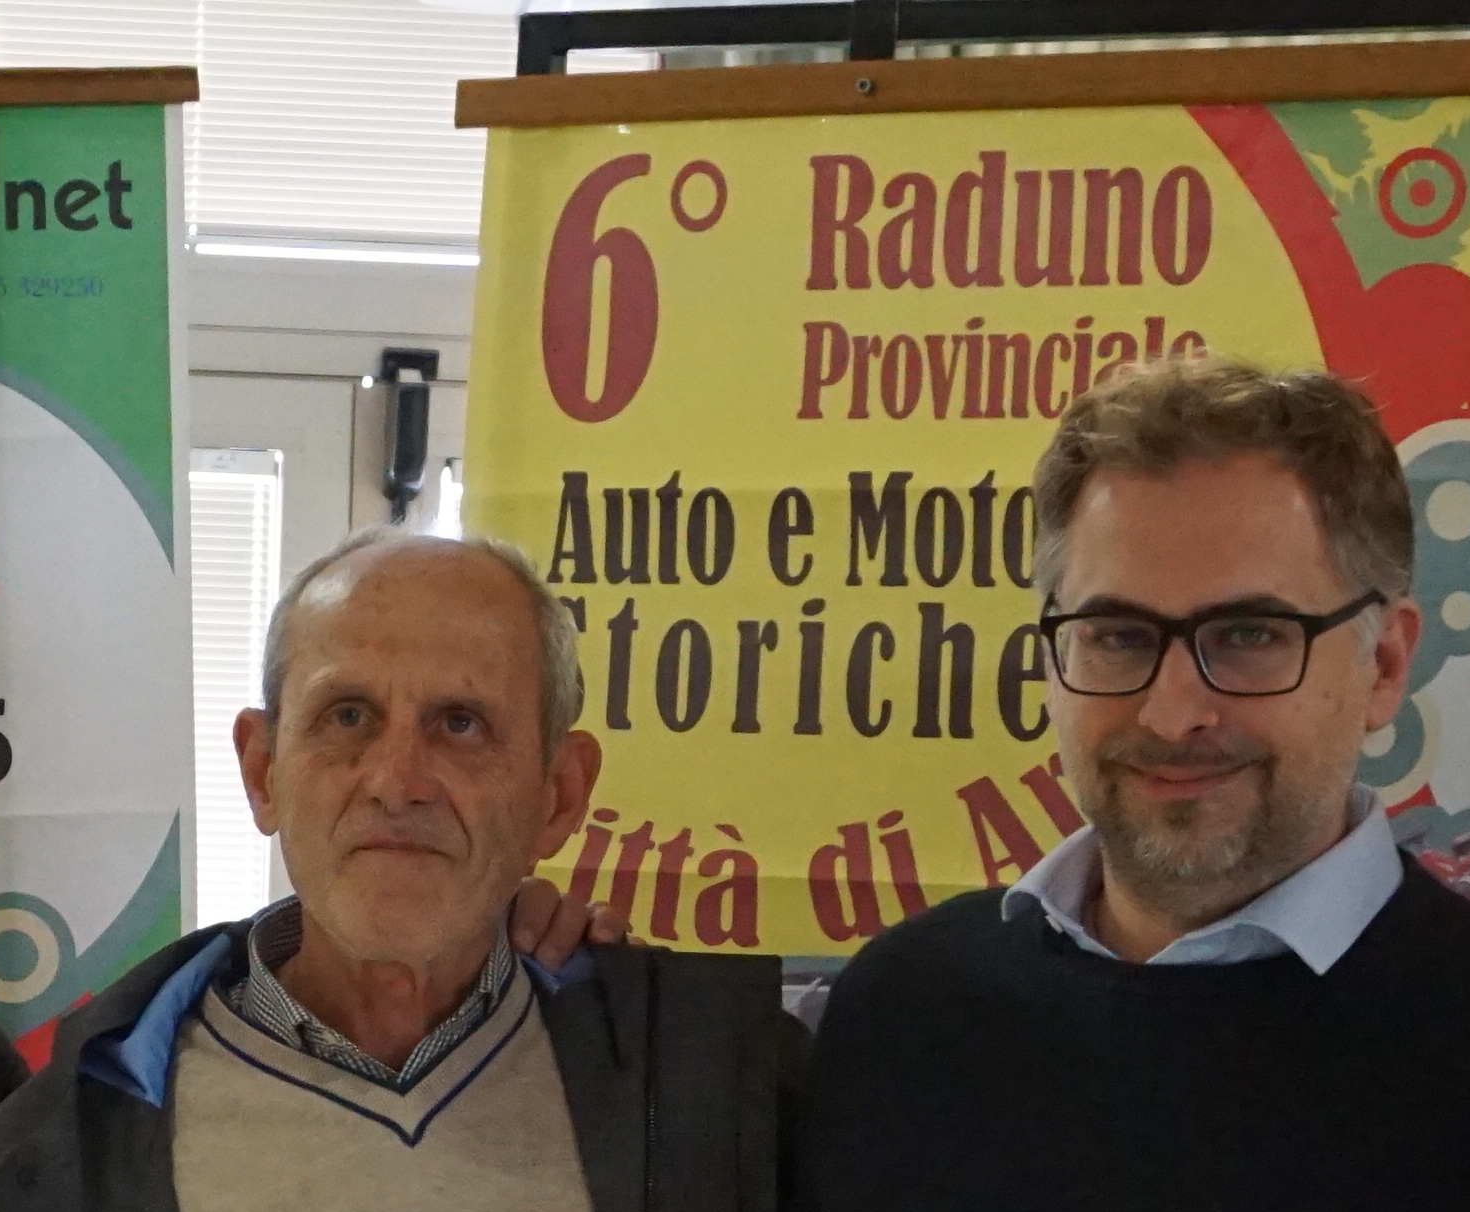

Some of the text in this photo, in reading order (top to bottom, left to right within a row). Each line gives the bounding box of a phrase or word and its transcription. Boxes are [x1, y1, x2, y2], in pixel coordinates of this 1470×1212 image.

[805, 150, 1213, 291] Raduno
[545, 469, 1037, 588] Auto e Moto
[807, 809, 929, 942] di
